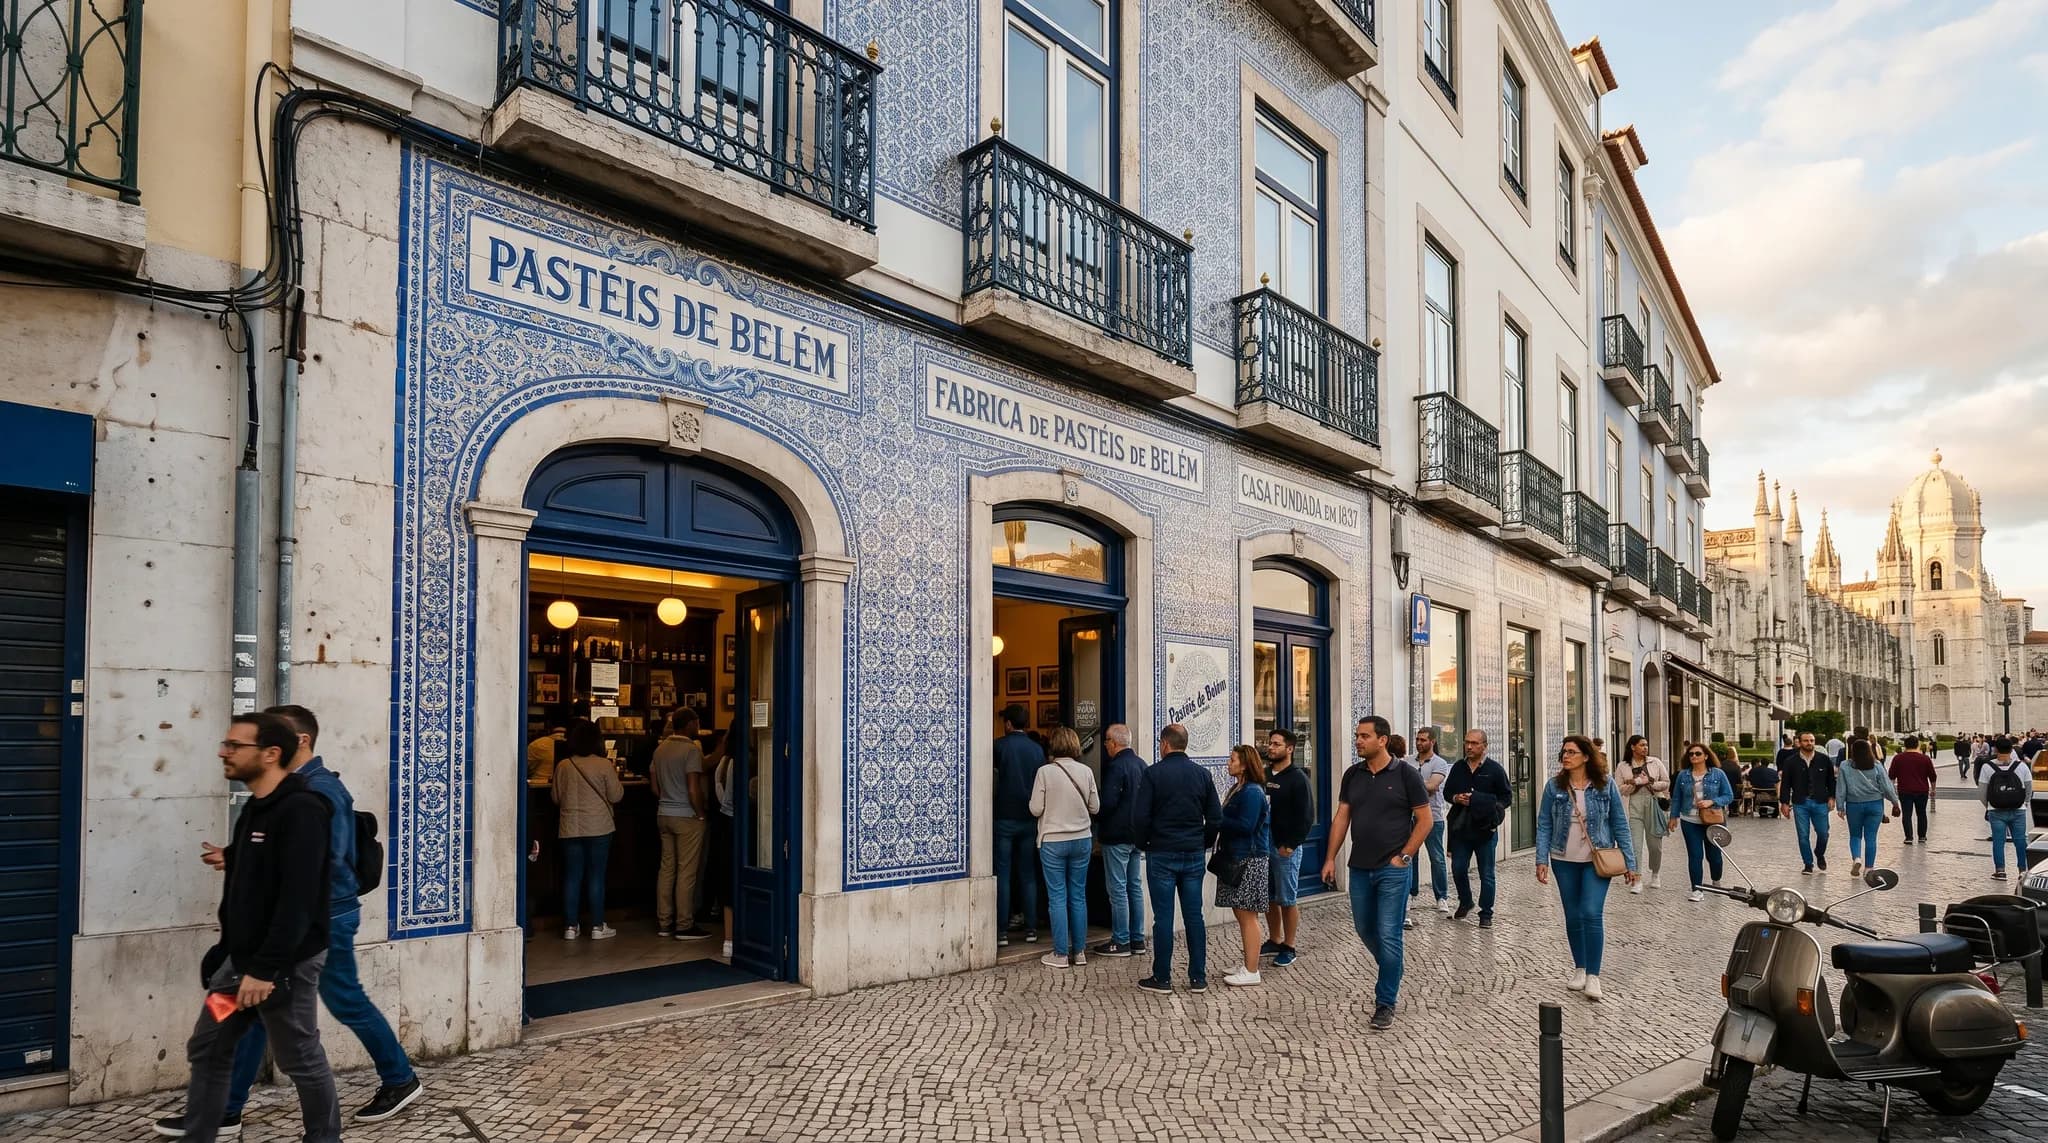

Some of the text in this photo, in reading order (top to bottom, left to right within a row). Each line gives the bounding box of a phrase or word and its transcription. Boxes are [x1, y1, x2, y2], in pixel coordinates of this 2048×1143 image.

[487, 236, 838, 381] PASTÉIS DE BELÉM
[935, 376, 1199, 484] FABRICA DE PASTÉIS DE BELÉM
[1241, 473, 1358, 529] CASA FUNDADA EM 1837
[1197, 691, 1205, 708] de
